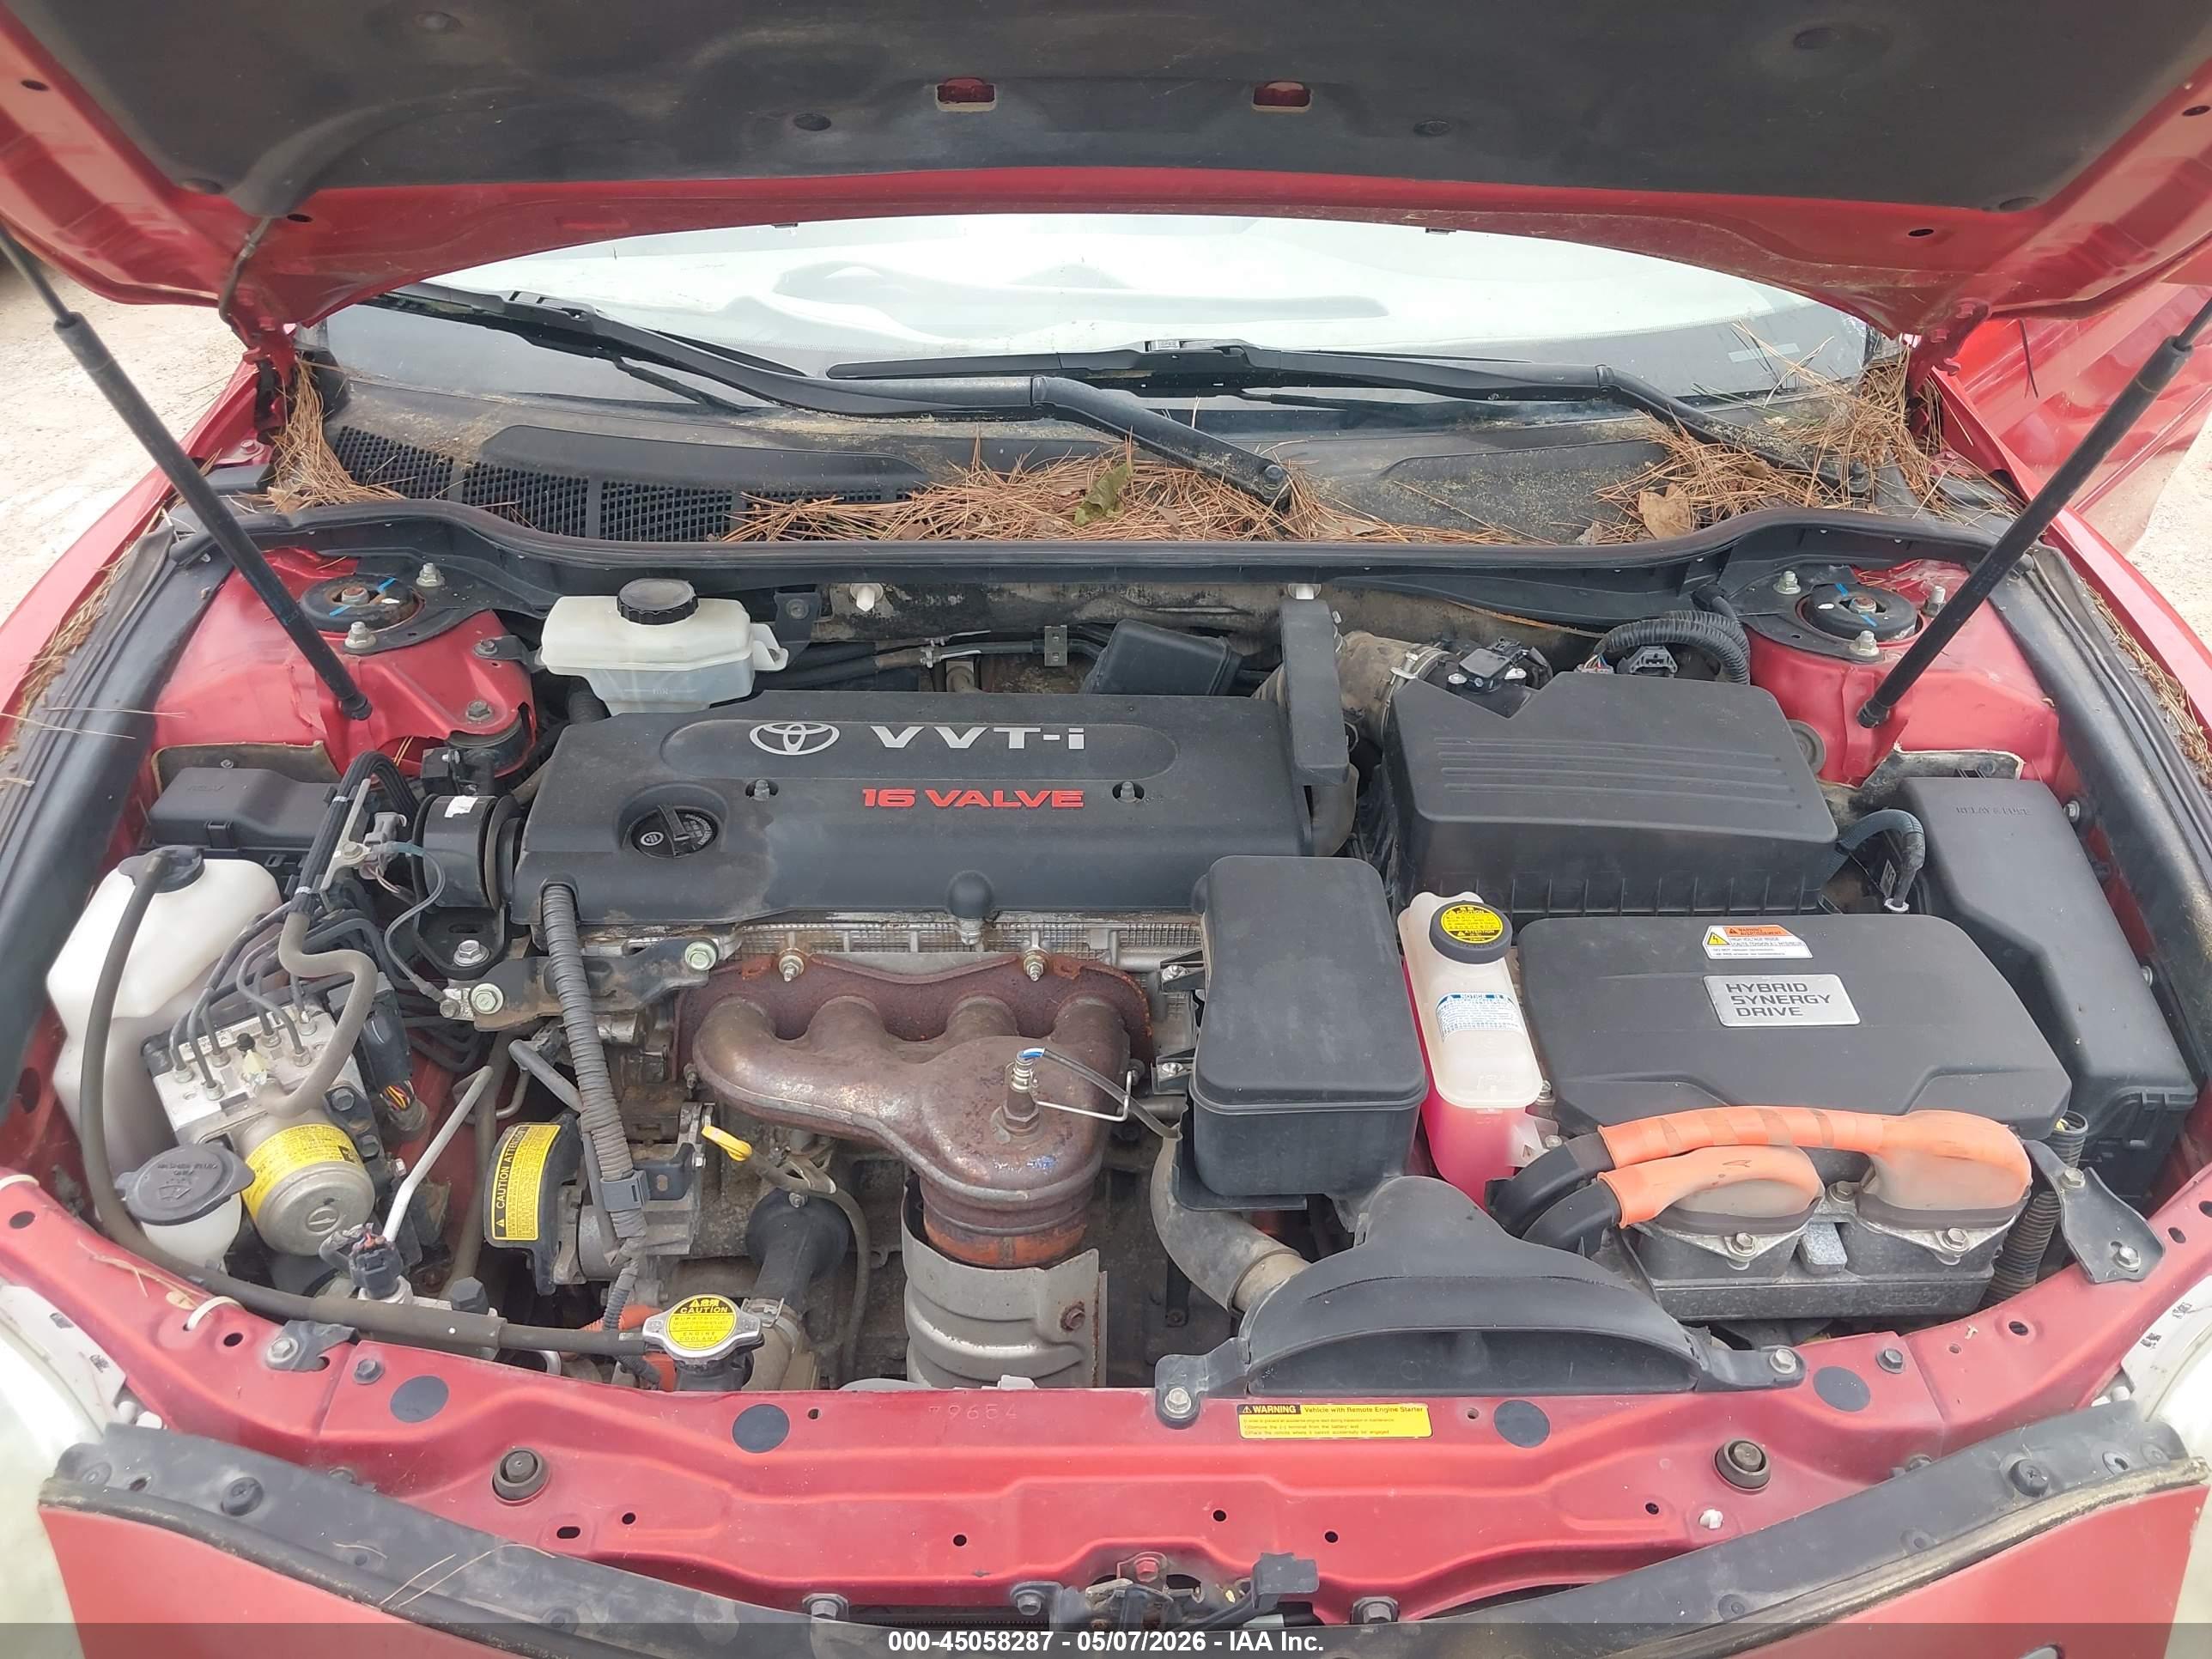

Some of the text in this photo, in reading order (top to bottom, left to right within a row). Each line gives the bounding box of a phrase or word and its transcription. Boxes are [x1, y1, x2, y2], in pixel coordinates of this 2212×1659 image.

[870, 726, 1085, 750] VVT-i
[862, 788, 1085, 808] 16 VALVE
[1725, 982, 1808, 994] HYBRID
[1730, 994, 1831, 1005] SYNERGY
[1736, 1006, 1804, 1017] DRIVE
[495, 1167, 510, 1209] CAUTION
[505, 1130, 526, 1164] ATTENTION
[1252, 1405, 1297, 1414] WARNING
